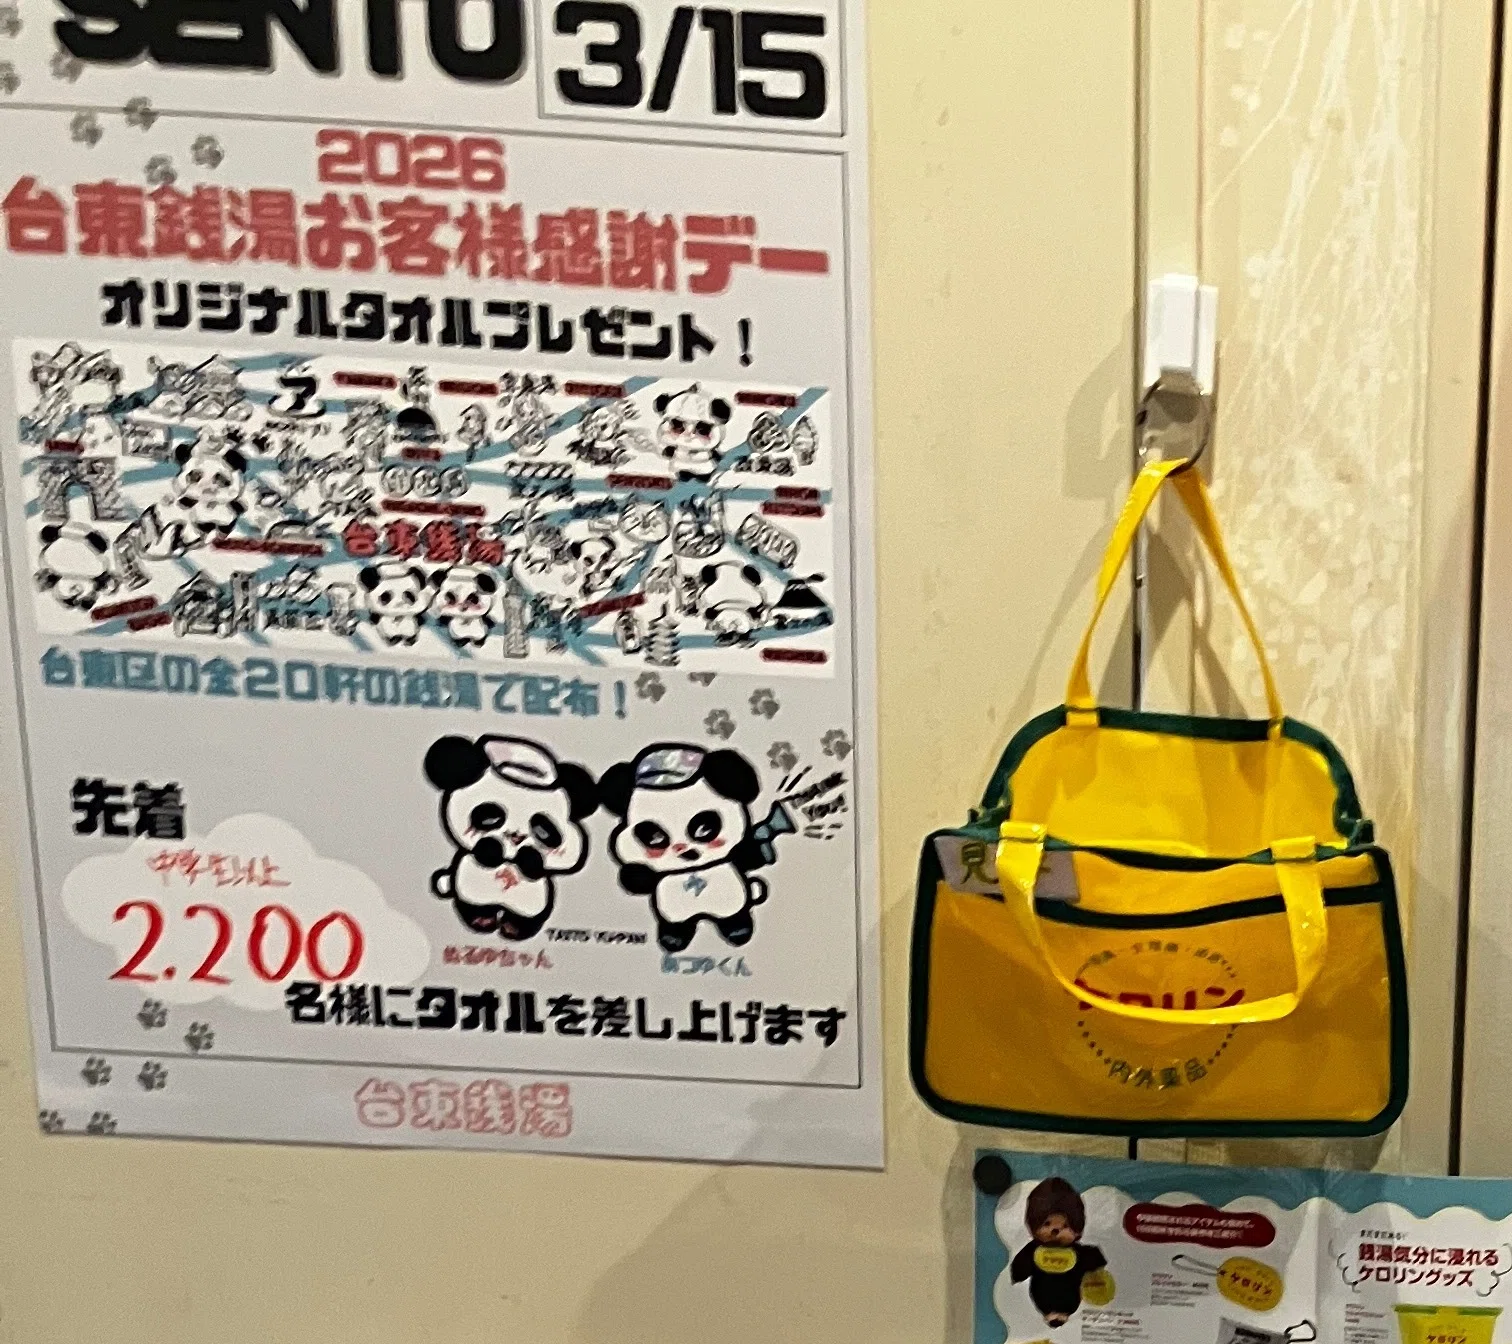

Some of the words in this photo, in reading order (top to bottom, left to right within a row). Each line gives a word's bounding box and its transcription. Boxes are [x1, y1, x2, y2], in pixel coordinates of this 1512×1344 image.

[552, 3, 828, 119] 3/15
[315, 128, 507, 193] 2026
[2, 174, 830, 294] 台東銭湯お客様感謝デー
[70, 777, 188, 840] 先着
[283, 981, 848, 1047] 名様にタオルを差し上げます
[1357, 1265, 1473, 1288] ケロリングッズ
